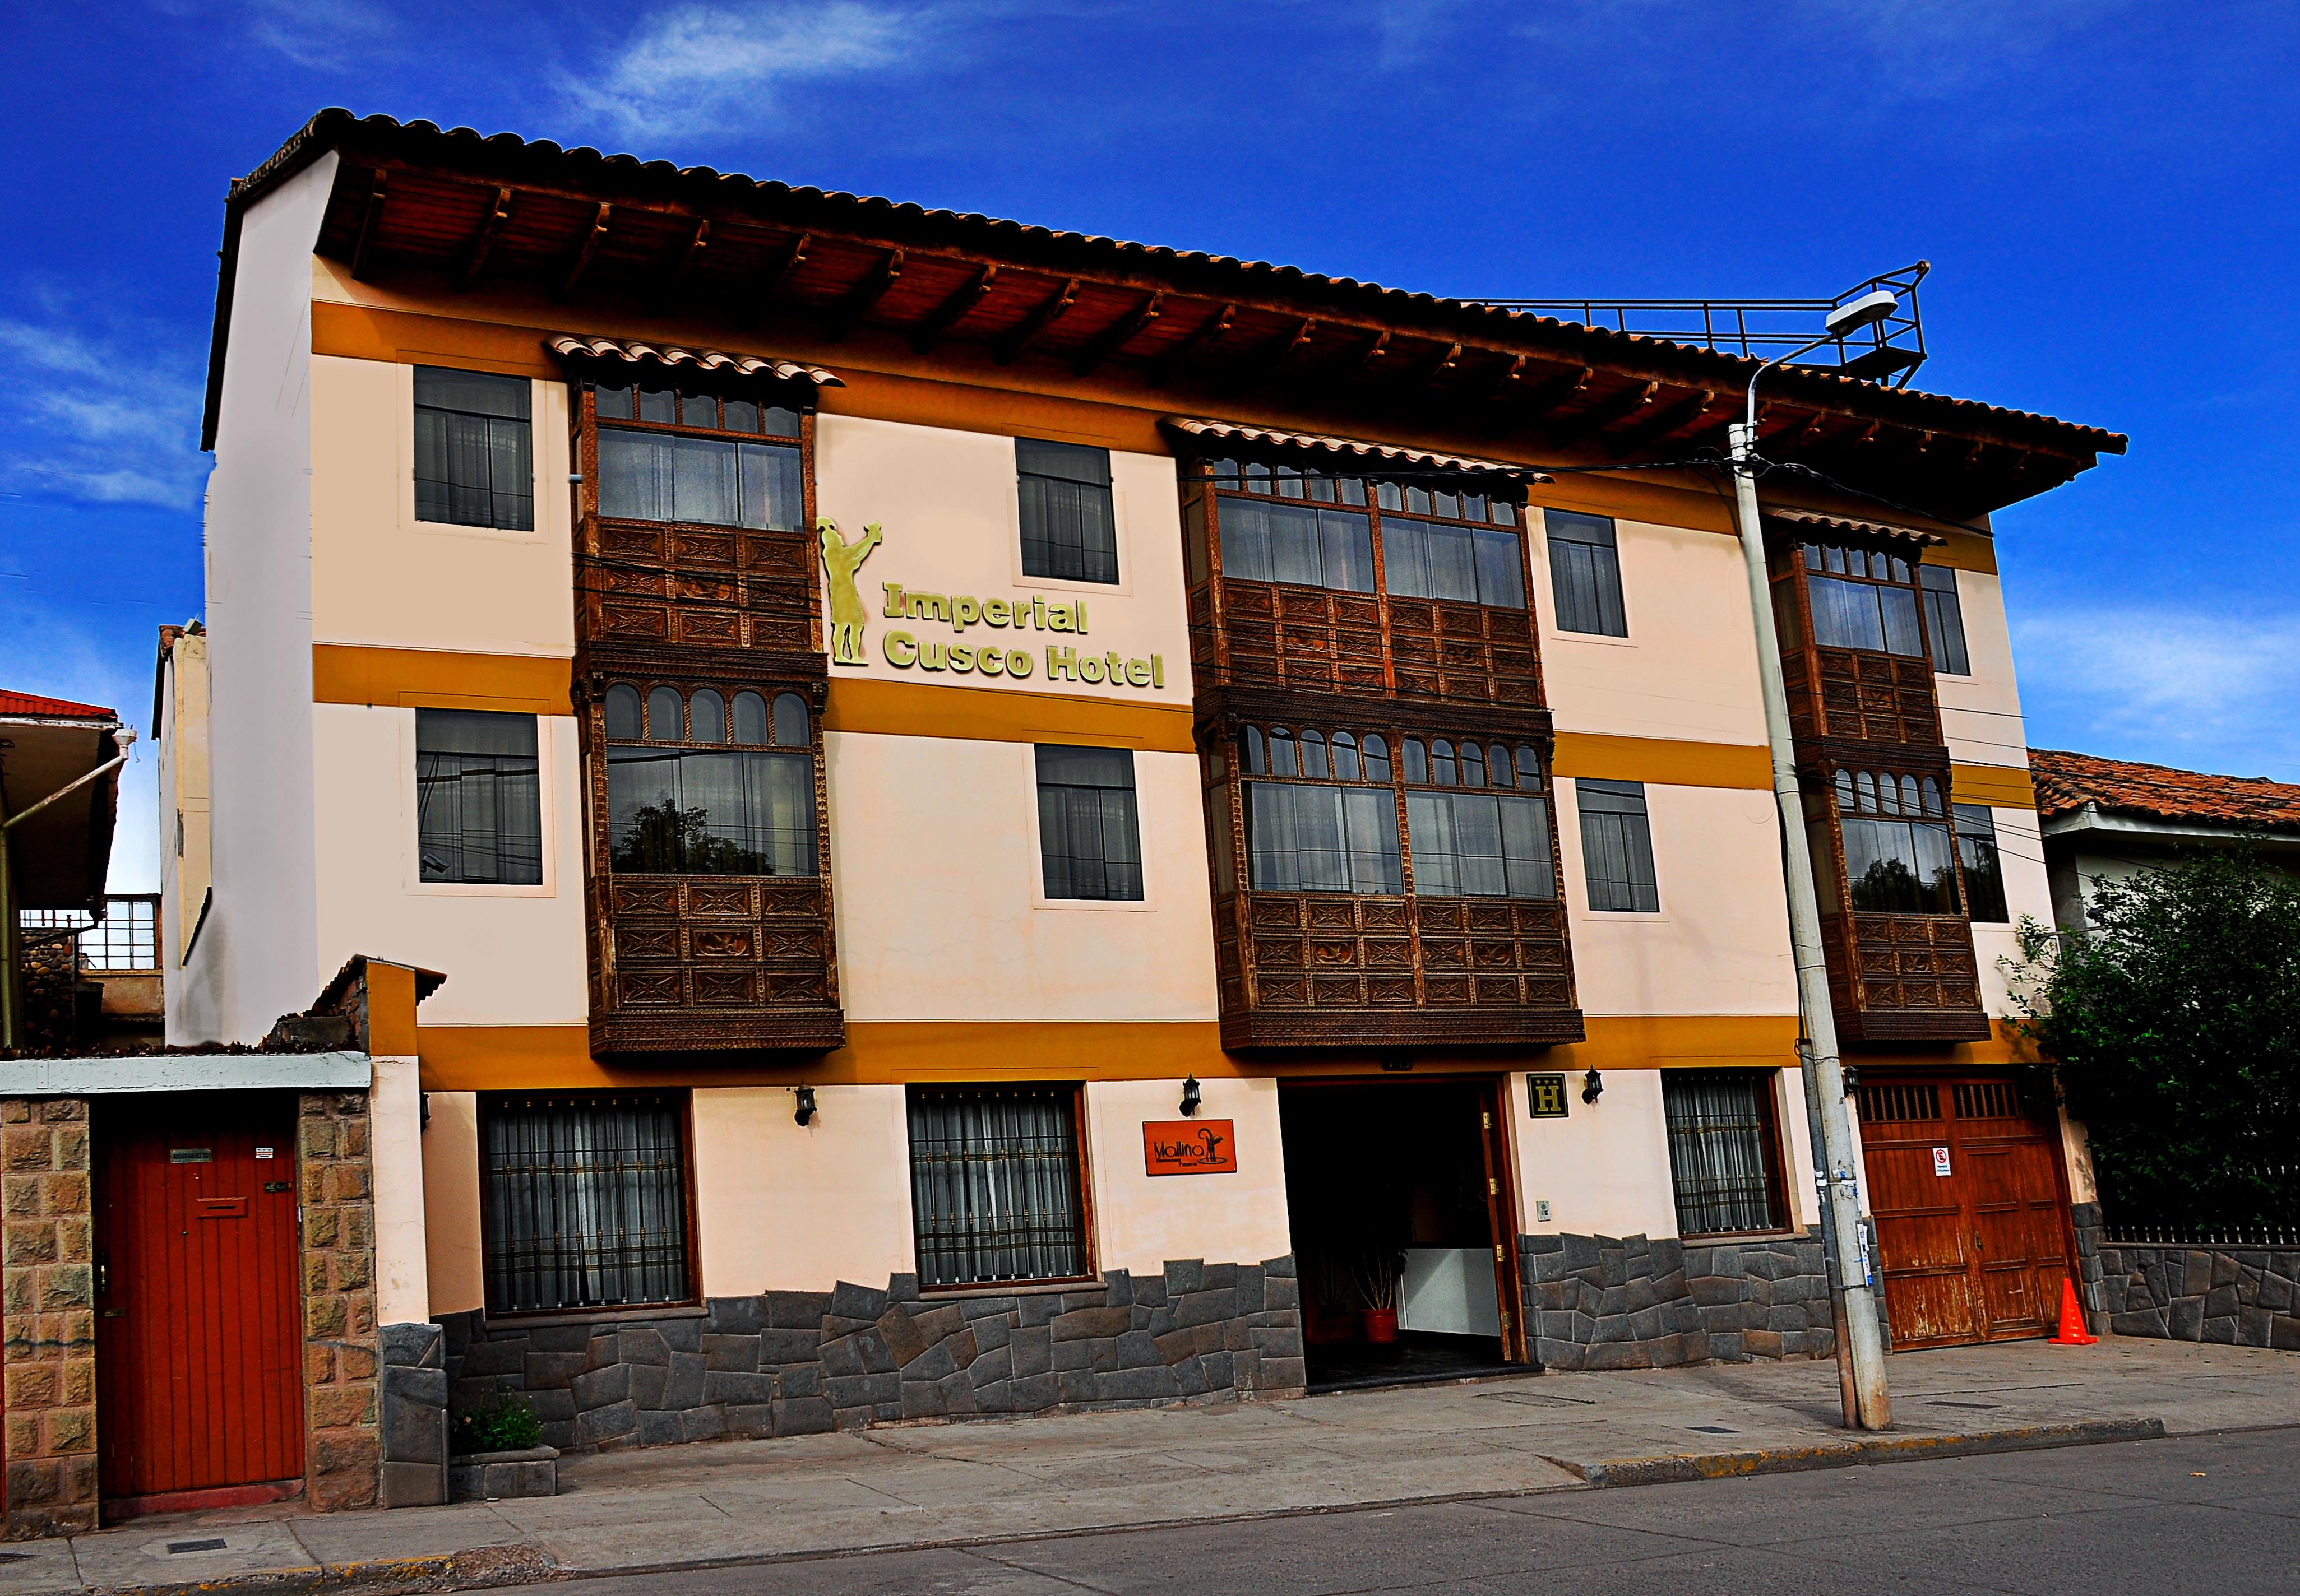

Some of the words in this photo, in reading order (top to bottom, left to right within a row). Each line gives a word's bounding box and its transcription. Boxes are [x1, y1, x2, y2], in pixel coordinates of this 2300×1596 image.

[883, 582, 1088, 634] Imperial
[883, 630, 1033, 676] Cusco
[1046, 645, 1164, 688] Hotel
[1535, 1085, 1561, 1112] H
